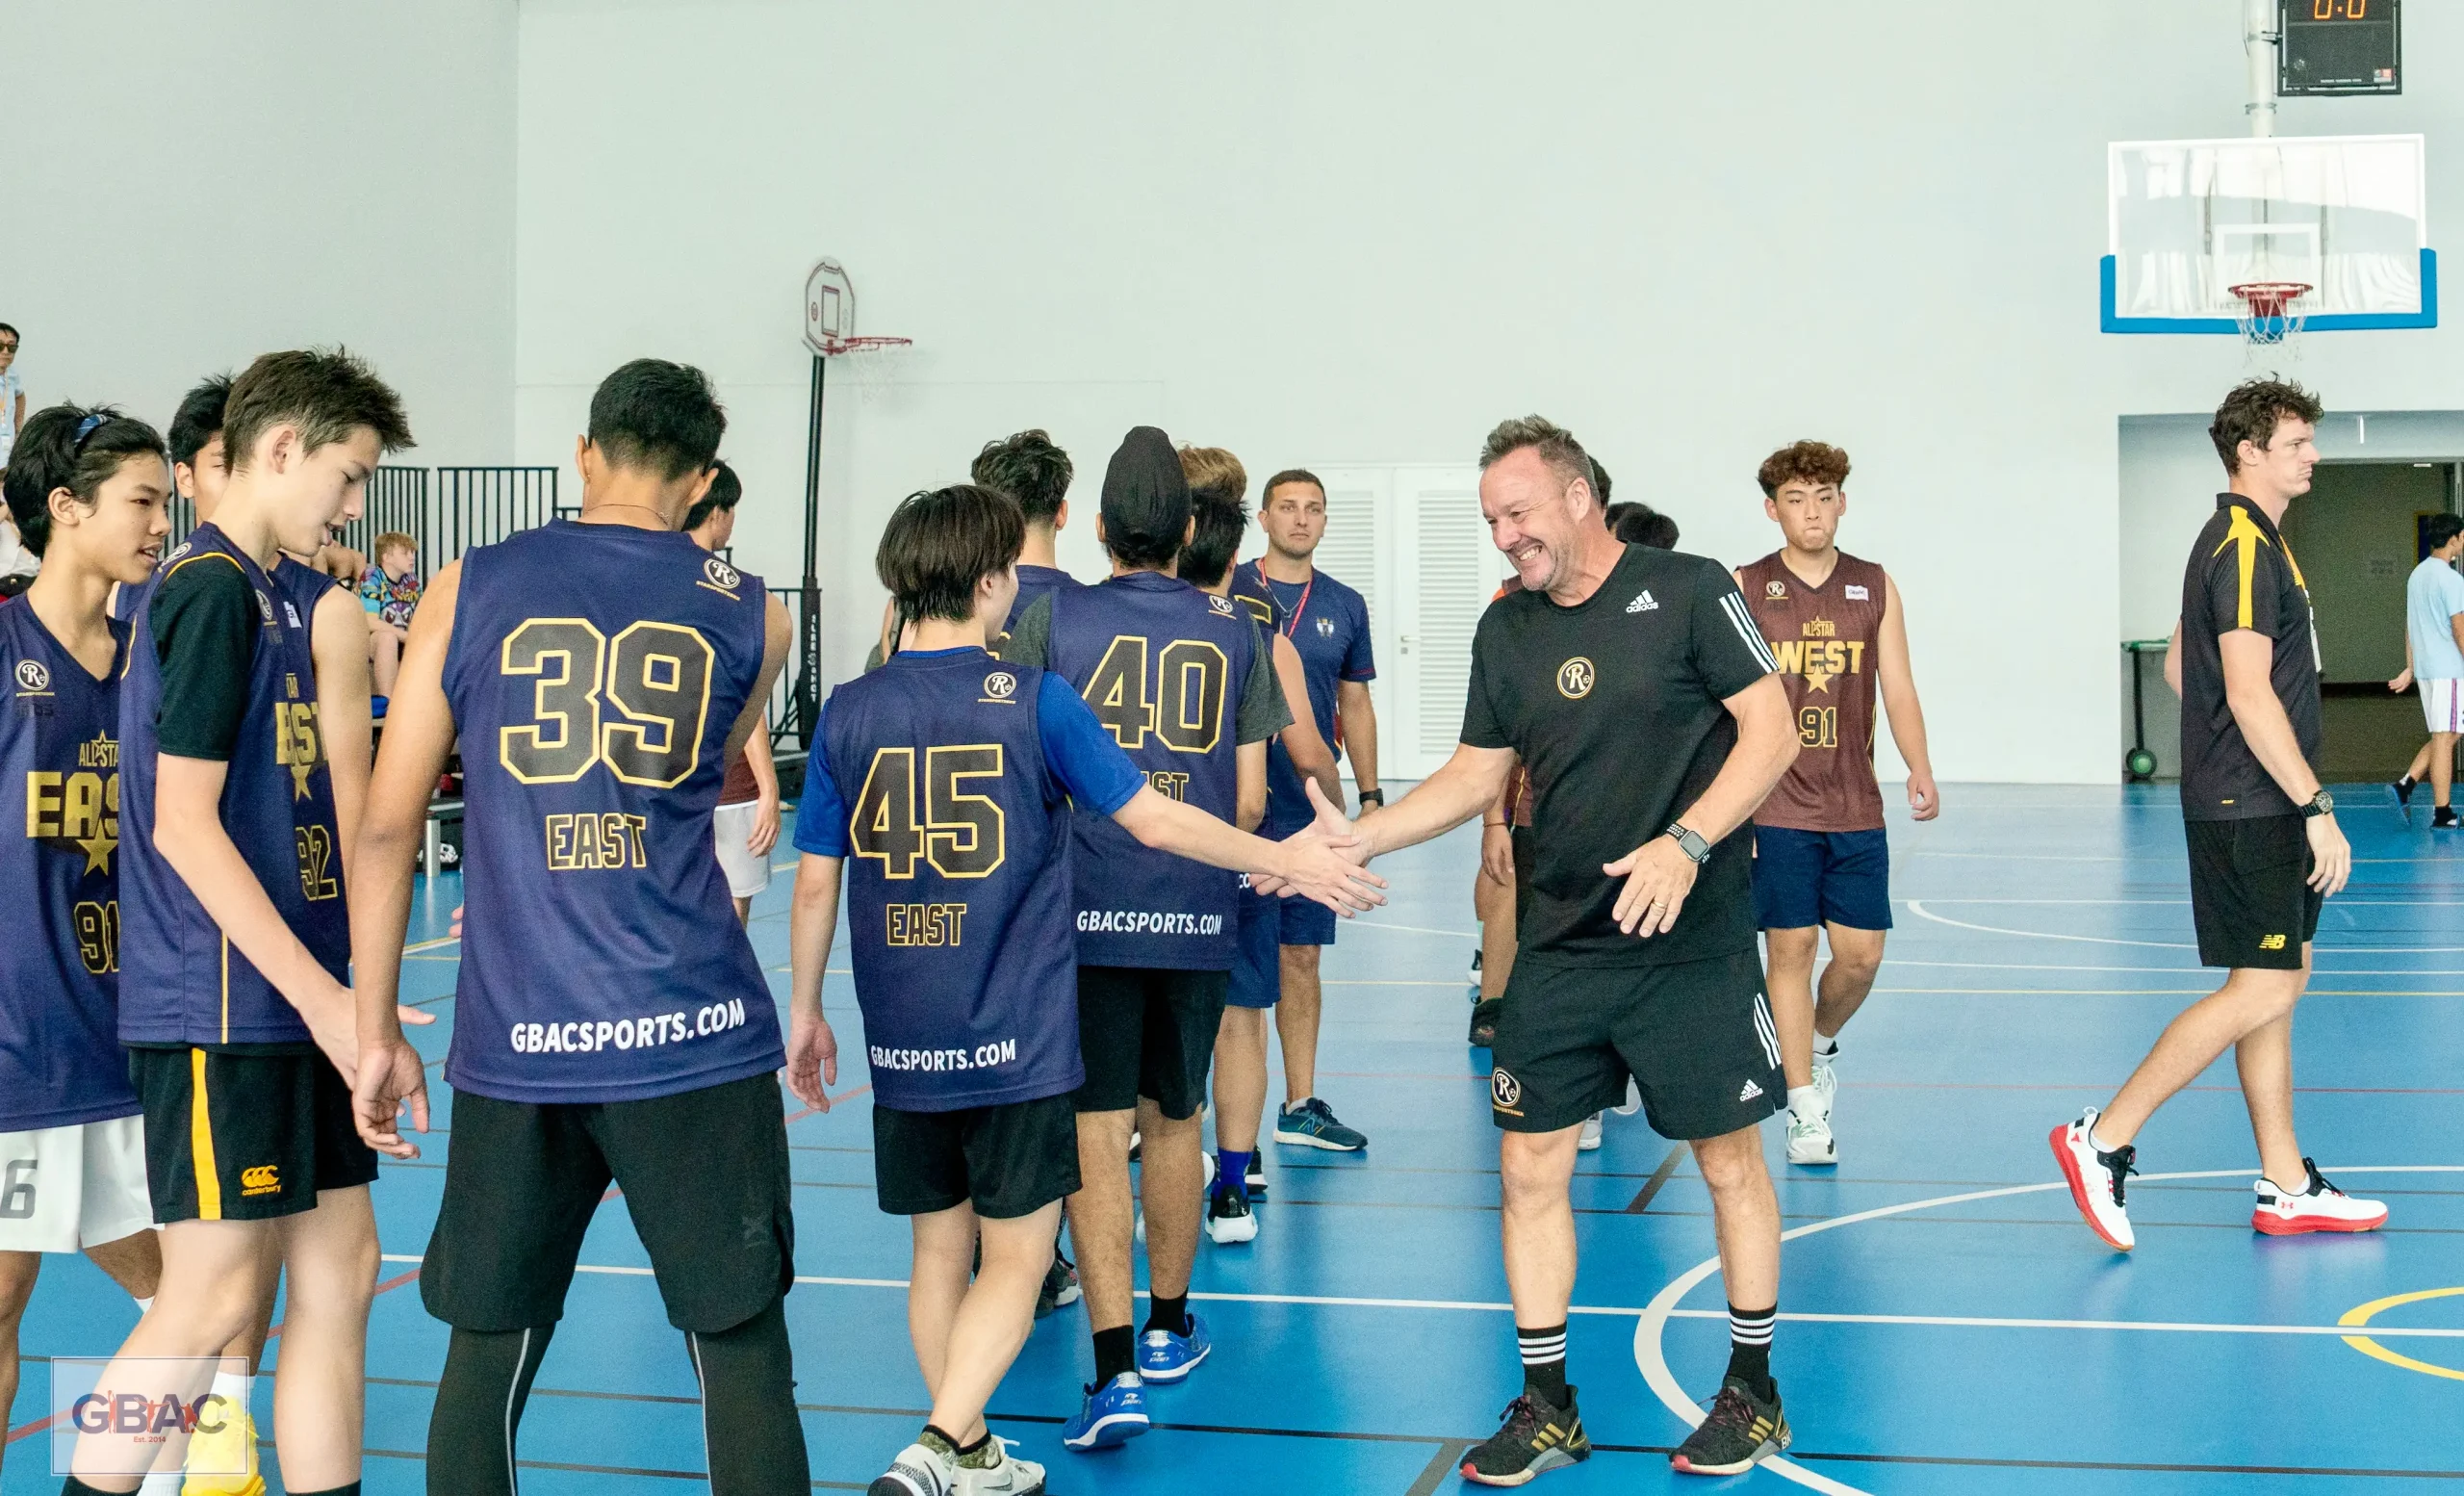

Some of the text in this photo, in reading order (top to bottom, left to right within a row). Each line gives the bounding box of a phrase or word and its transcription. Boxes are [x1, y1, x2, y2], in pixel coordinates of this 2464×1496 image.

[1626, 602, 1658, 613] adidas
[1771, 640, 1865, 674] WEST
[500, 618, 715, 788] 39
[1083, 635, 1227, 754] 40
[1798, 706, 1837, 748] 91
[849, 744, 1005, 880] 45
[295, 824, 339, 901] 92
[546, 813, 647, 870] EAST
[74, 900, 120, 974] 91
[886, 903, 967, 947] EAST
[1076, 910, 1222, 936] GBACSPORTS.COM
[510, 997, 746, 1053] GBACSPORTS.COM
[870, 1038, 1016, 1072] GBACSPORTS.COM
[1739, 1087, 1763, 1102] adidas
[0, 1160, 38, 1219] 6
